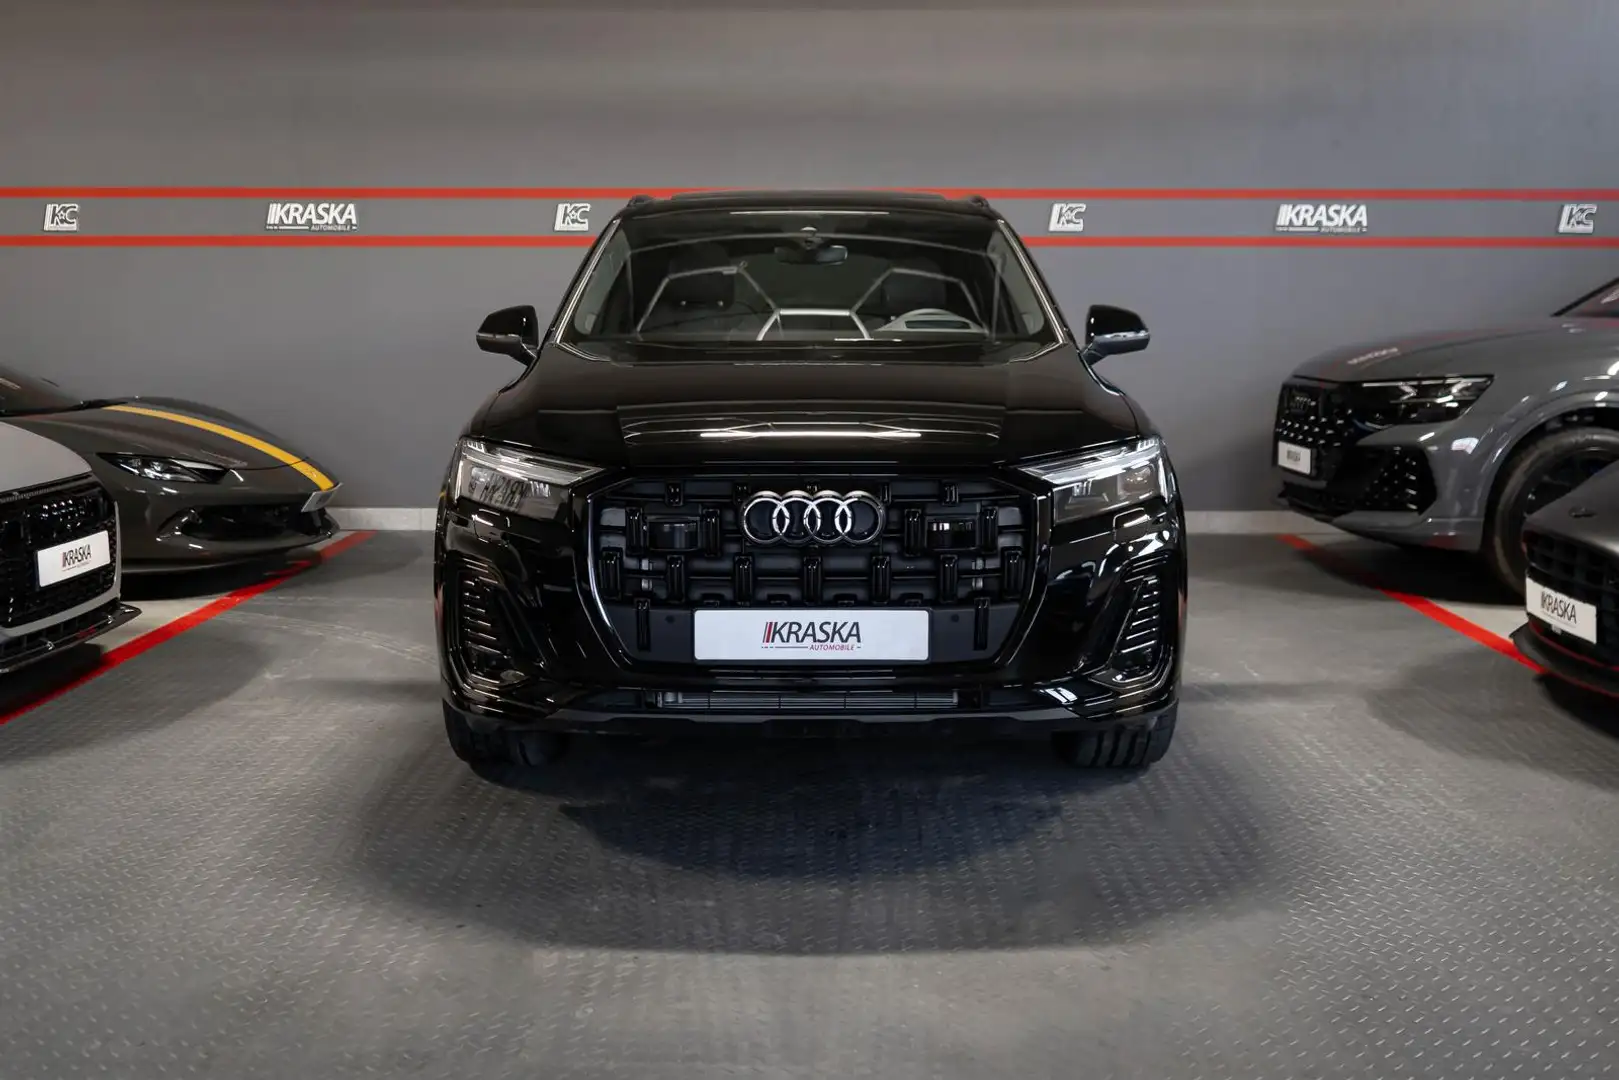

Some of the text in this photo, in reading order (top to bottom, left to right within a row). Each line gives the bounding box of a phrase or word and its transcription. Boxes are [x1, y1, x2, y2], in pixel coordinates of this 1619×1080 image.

[274, 203, 357, 225] KRASKA
[1285, 203, 1368, 227] KRASKA
[62, 544, 92, 568] KRASKA
[1541, 591, 1577, 625] KRASKA
[770, 621, 861, 643] KRASKA
